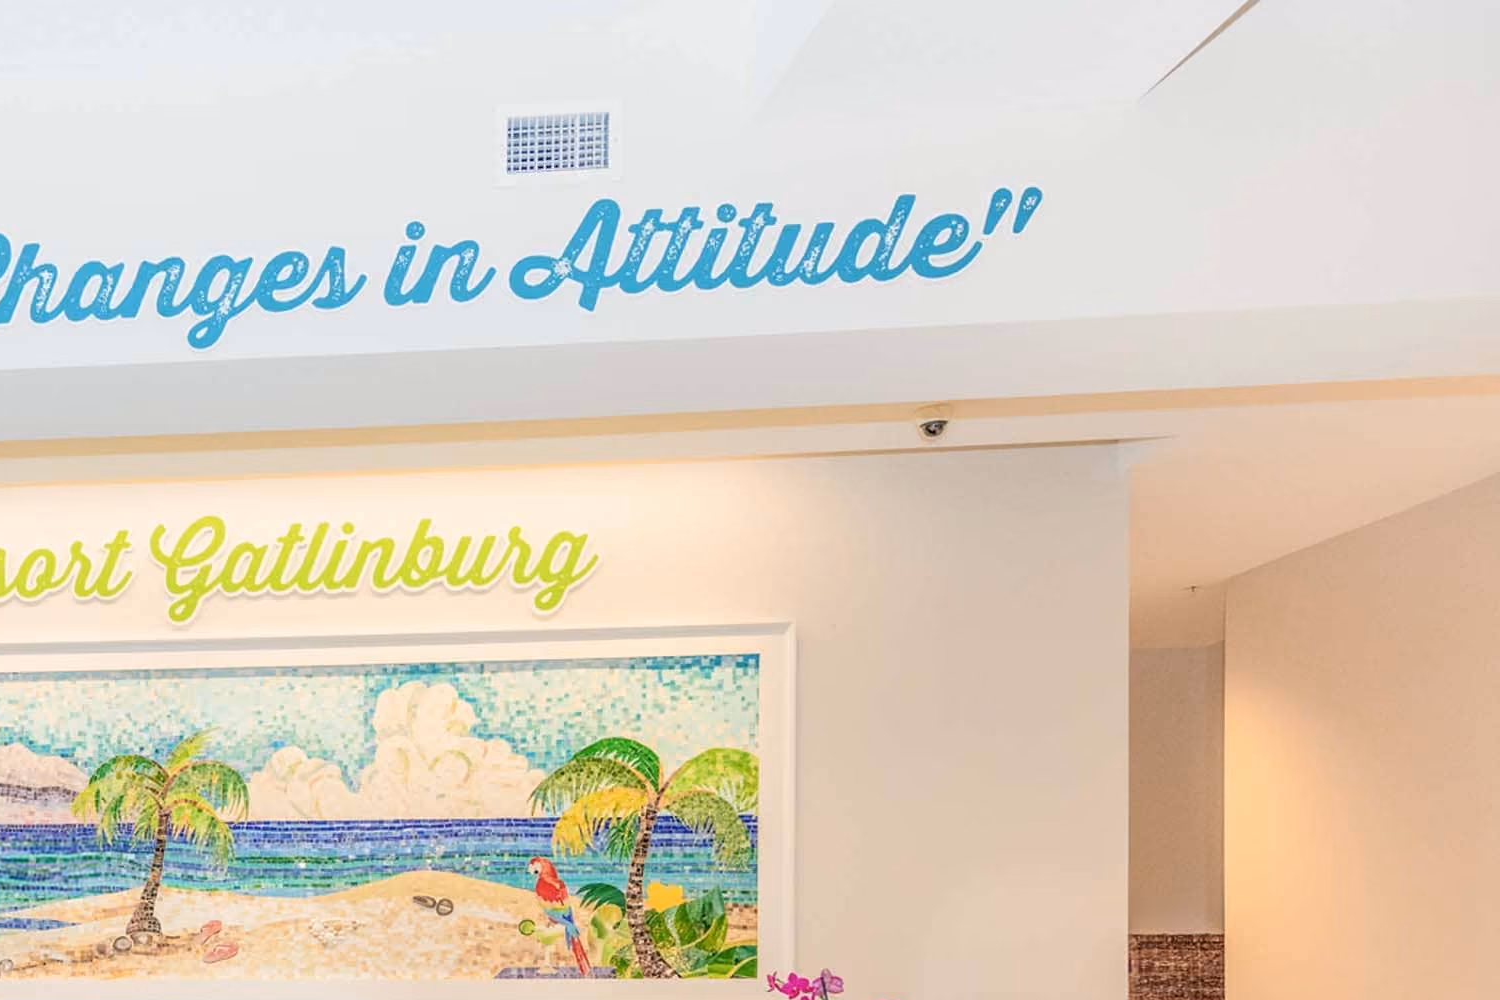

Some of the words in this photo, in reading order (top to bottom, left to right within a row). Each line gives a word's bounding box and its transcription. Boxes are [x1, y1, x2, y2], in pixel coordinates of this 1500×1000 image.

[383, 221, 497, 307] in
[508, 186, 1043, 312] Attitude"
[150, 515, 599, 622] Gatlinburg
